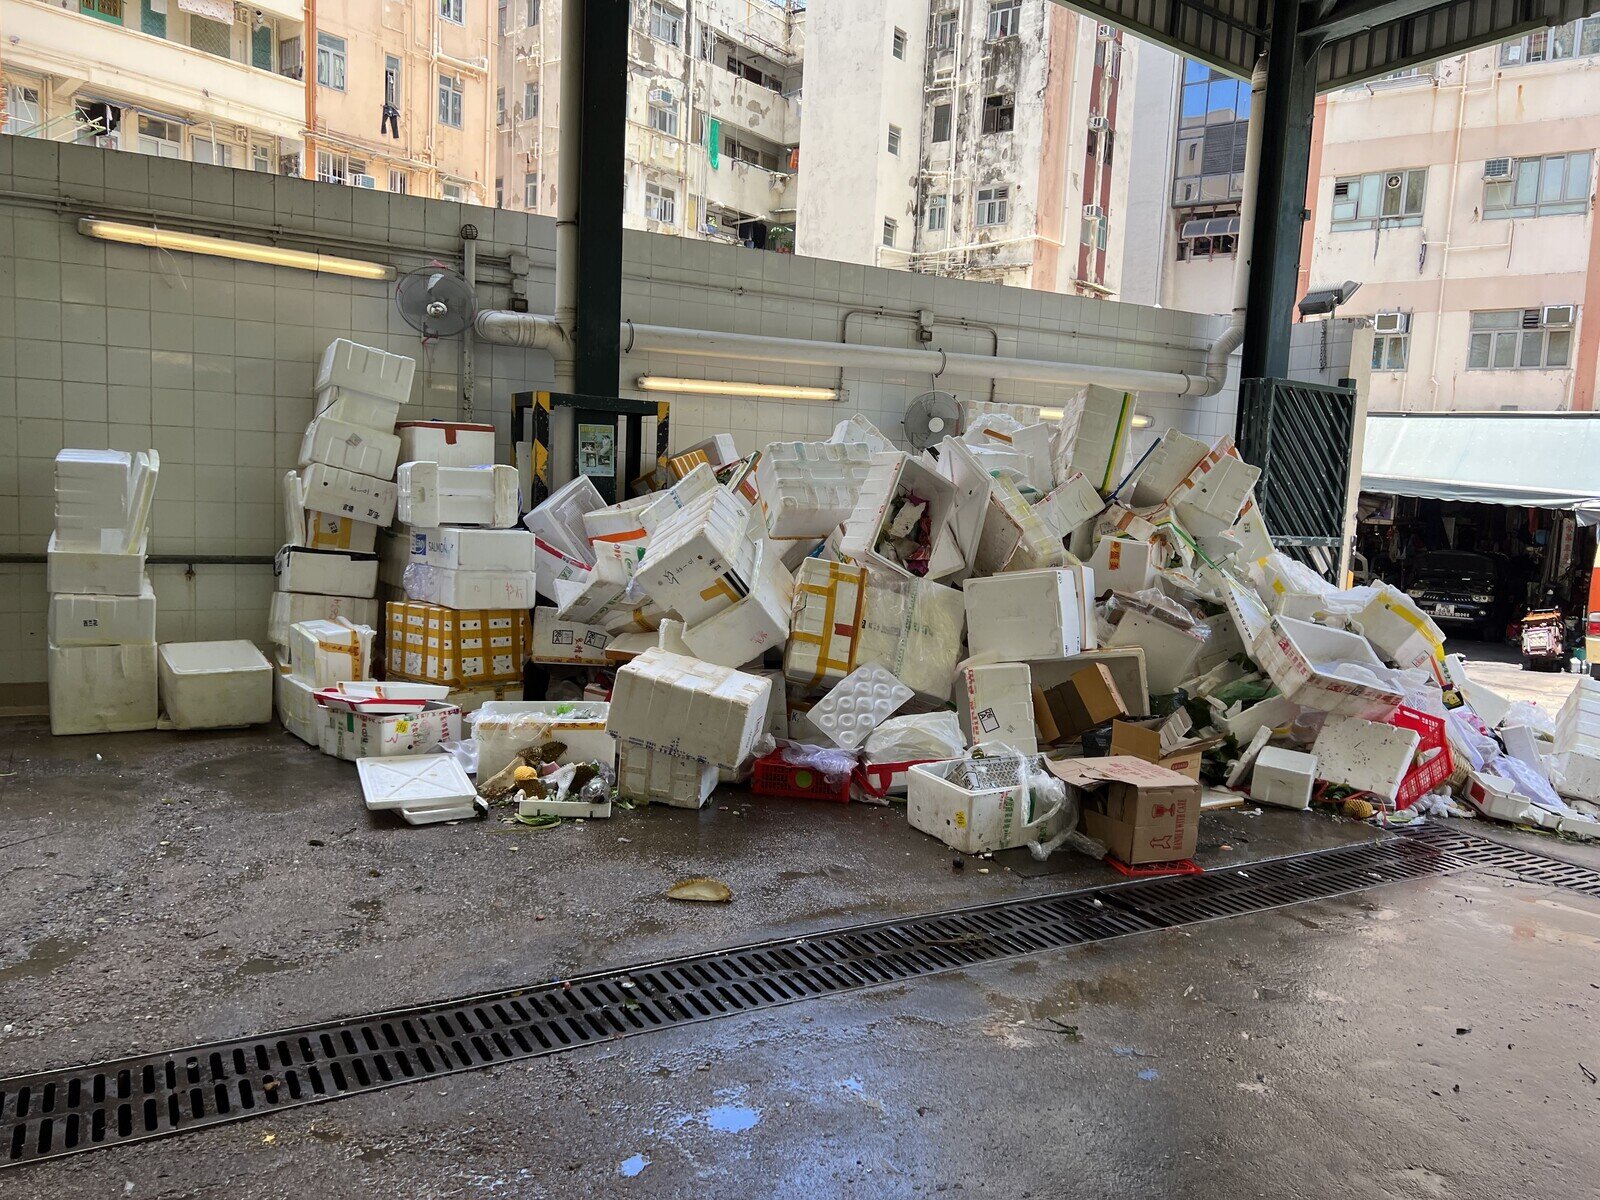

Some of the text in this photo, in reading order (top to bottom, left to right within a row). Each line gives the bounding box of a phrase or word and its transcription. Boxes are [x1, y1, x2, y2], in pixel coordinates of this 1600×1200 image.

[1174, 799, 1187, 850] HANDLE WITH CARE
